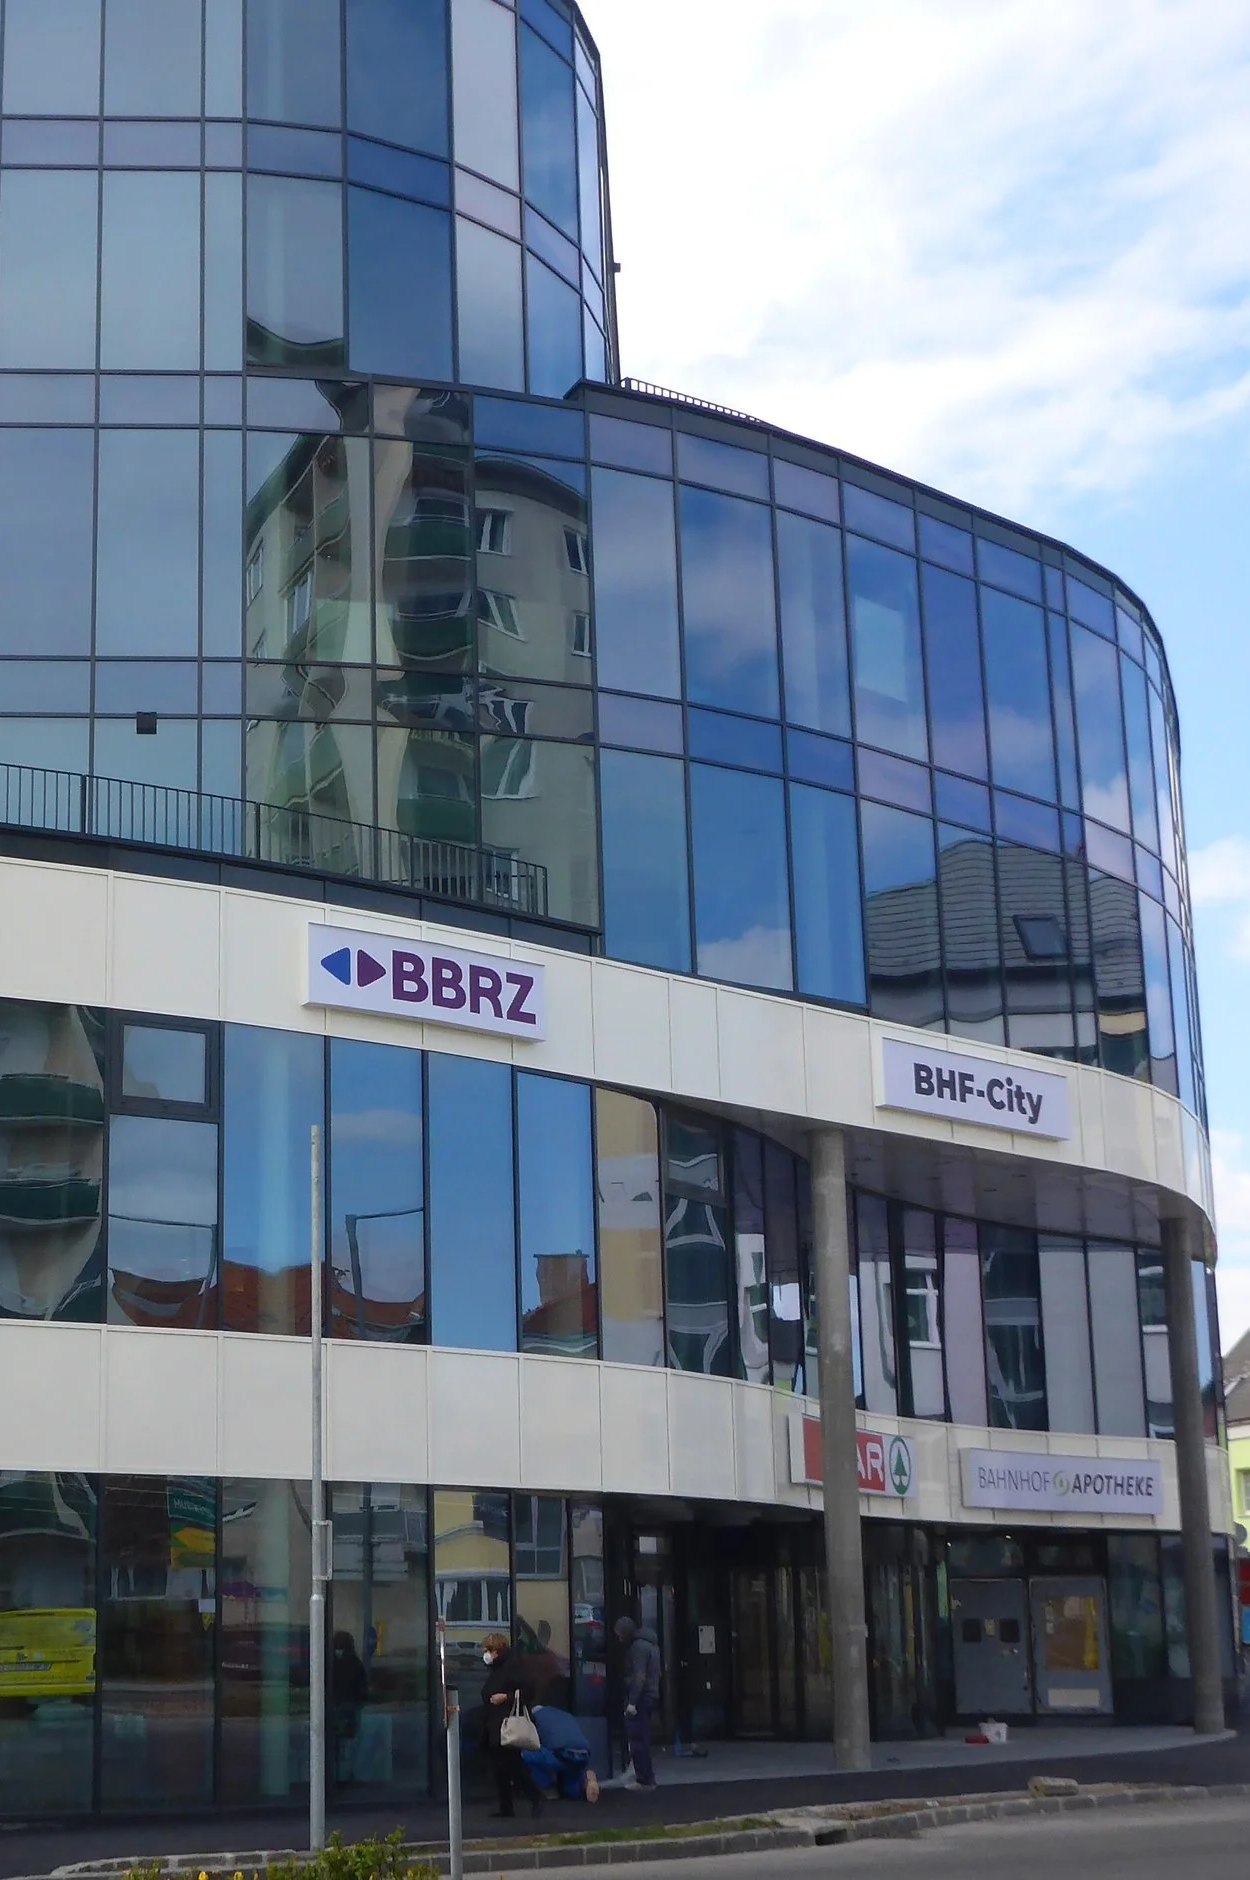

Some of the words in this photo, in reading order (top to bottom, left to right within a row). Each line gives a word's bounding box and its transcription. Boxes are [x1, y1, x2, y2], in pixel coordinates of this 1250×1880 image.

[392, 949, 536, 1025] BBRZ
[913, 1062, 1043, 1124] BHF-City
[978, 1466, 1050, 1493] BAHNHOF
[1071, 1473, 1154, 1497] APOTHEKE
